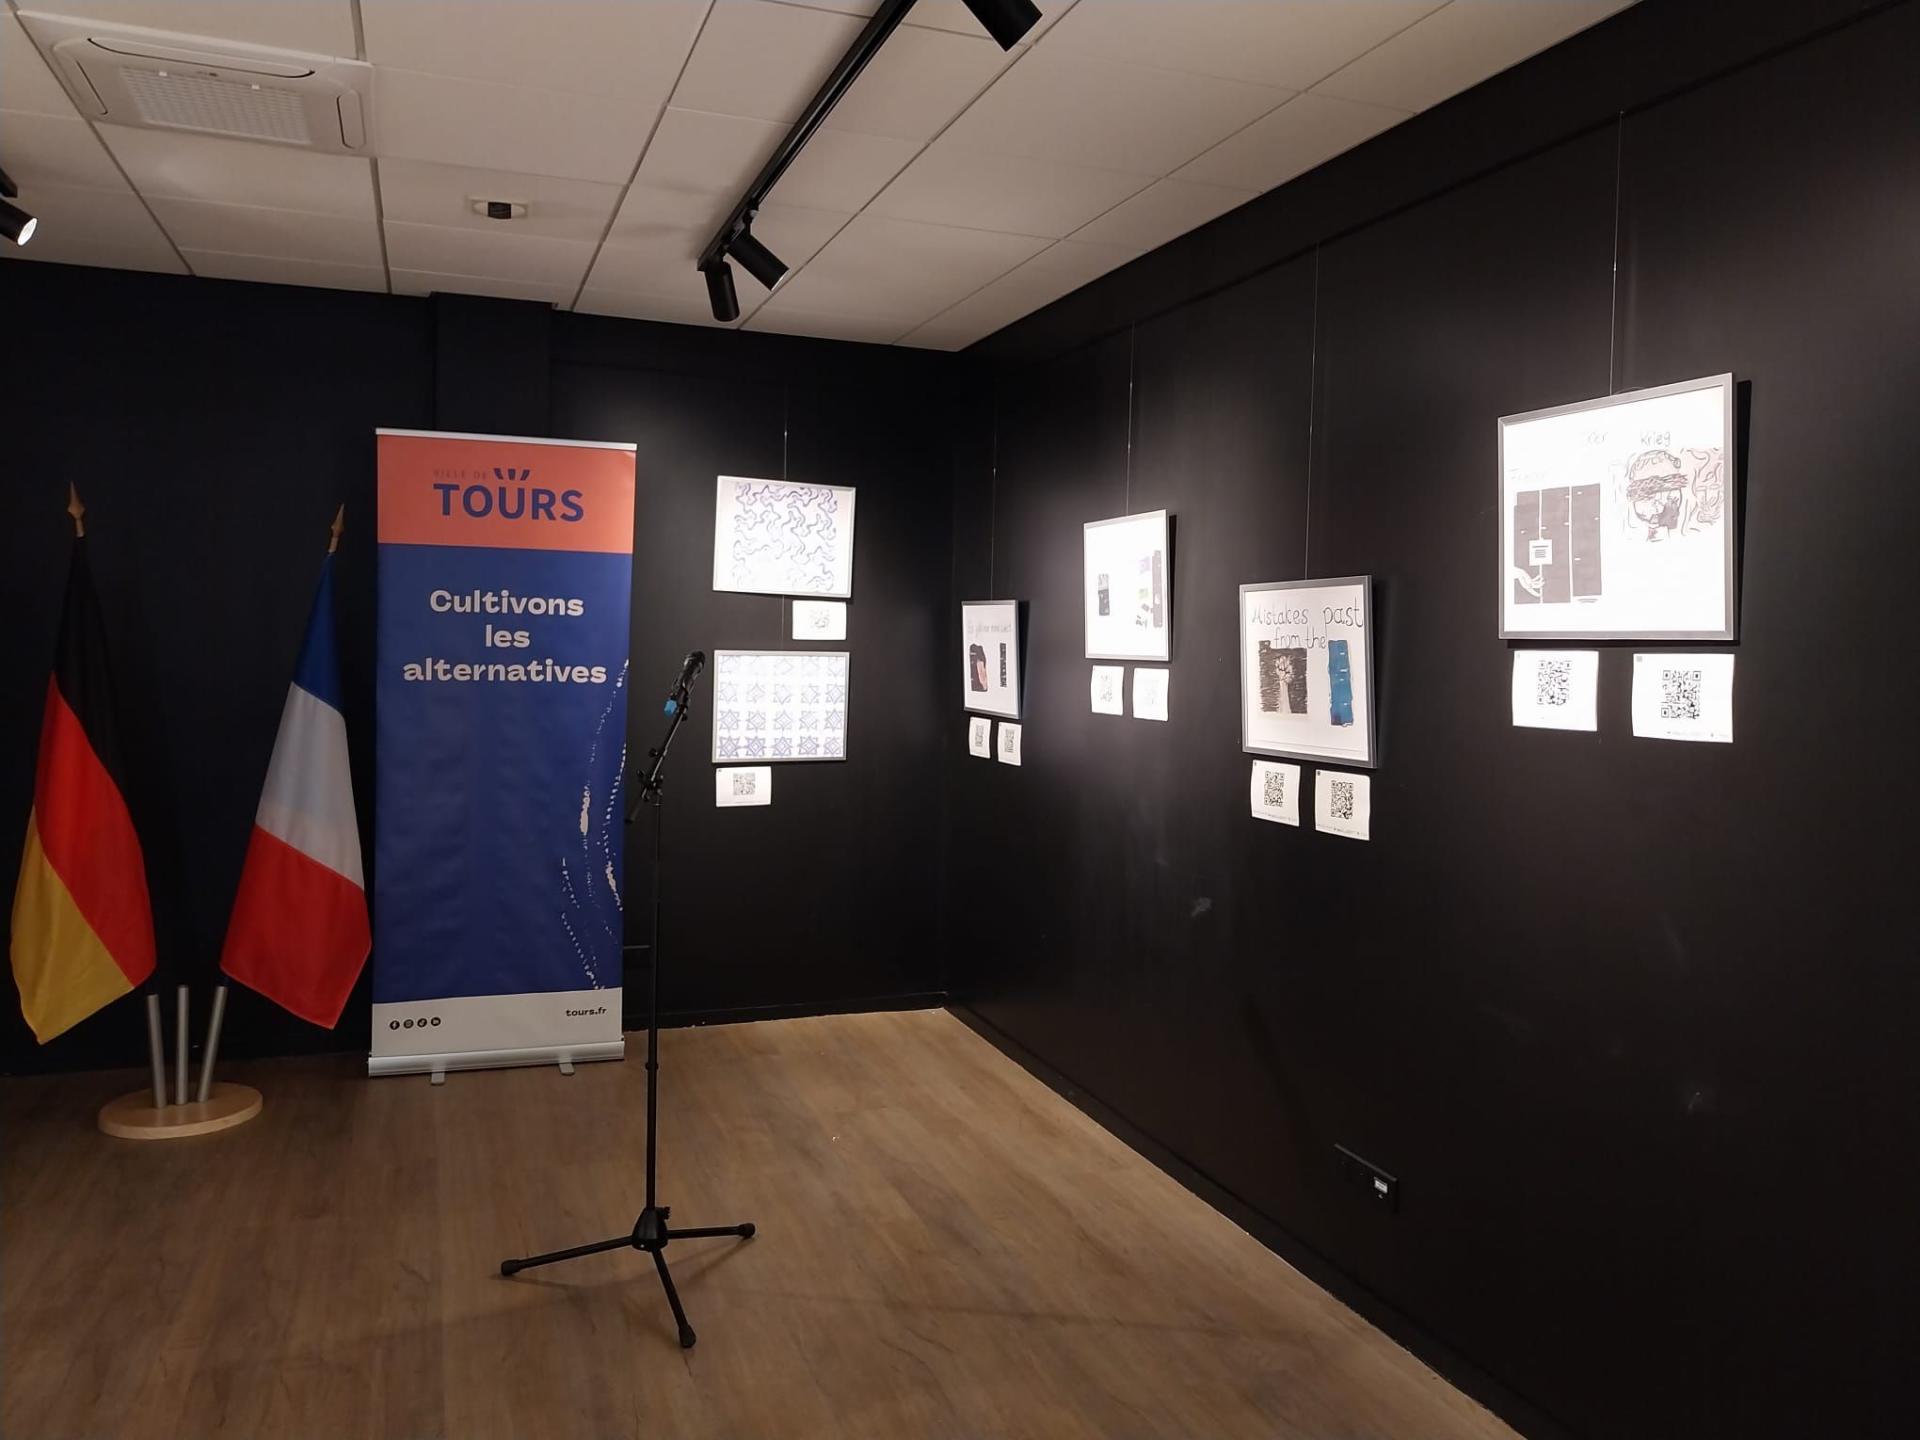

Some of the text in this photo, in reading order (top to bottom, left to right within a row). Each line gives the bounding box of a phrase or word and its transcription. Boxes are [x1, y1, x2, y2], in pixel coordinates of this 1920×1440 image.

[433, 483, 584, 522] TOURS
[429, 589, 585, 616] Cultivons
[1322, 595, 1364, 637] past
[485, 624, 531, 648] les
[1273, 625, 1327, 649] from the
[402, 657, 608, 684] alternatives
[565, 1006, 607, 1017] tours.fr
